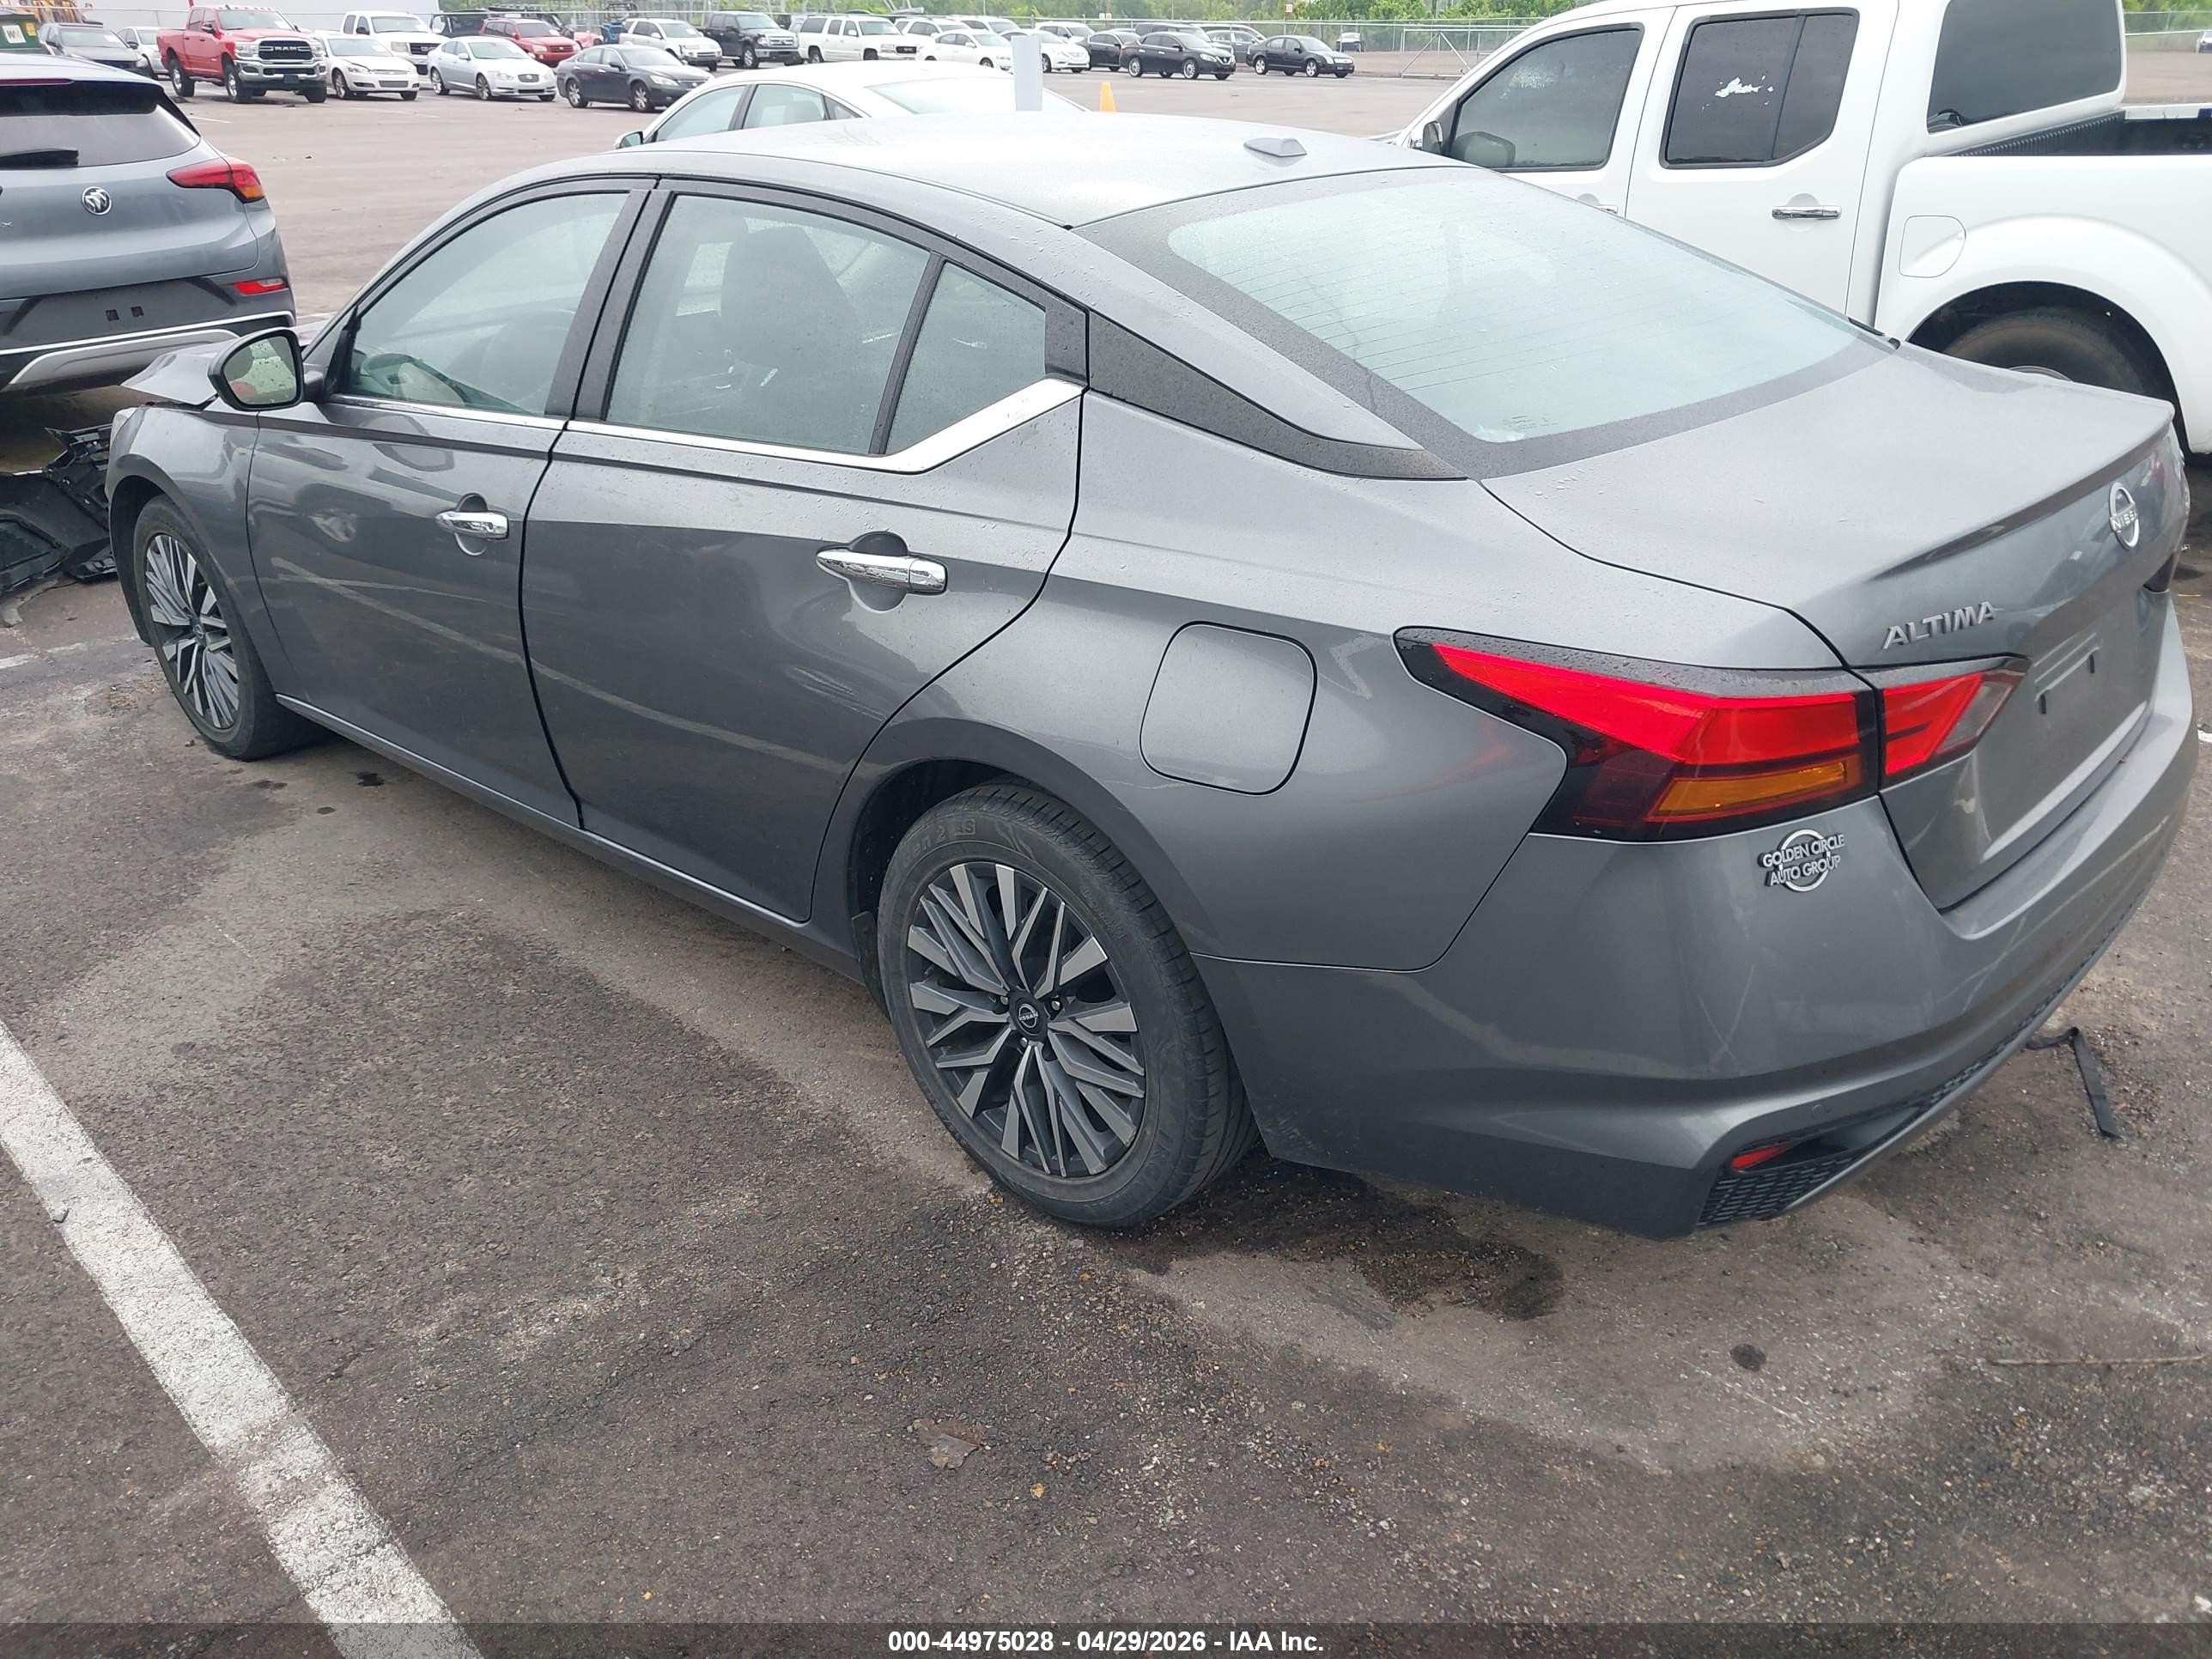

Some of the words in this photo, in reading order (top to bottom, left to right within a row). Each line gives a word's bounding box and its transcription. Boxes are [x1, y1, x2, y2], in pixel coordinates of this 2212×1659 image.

[2110, 509, 2137, 532] NISS
[1882, 601, 1996, 650] ALTIMA
[1762, 842, 1811, 868] GOLDEN
[1810, 834, 1845, 854] CIRCLE
[1770, 866, 1802, 887] AUTO
[1802, 854, 1841, 877] GROUP
